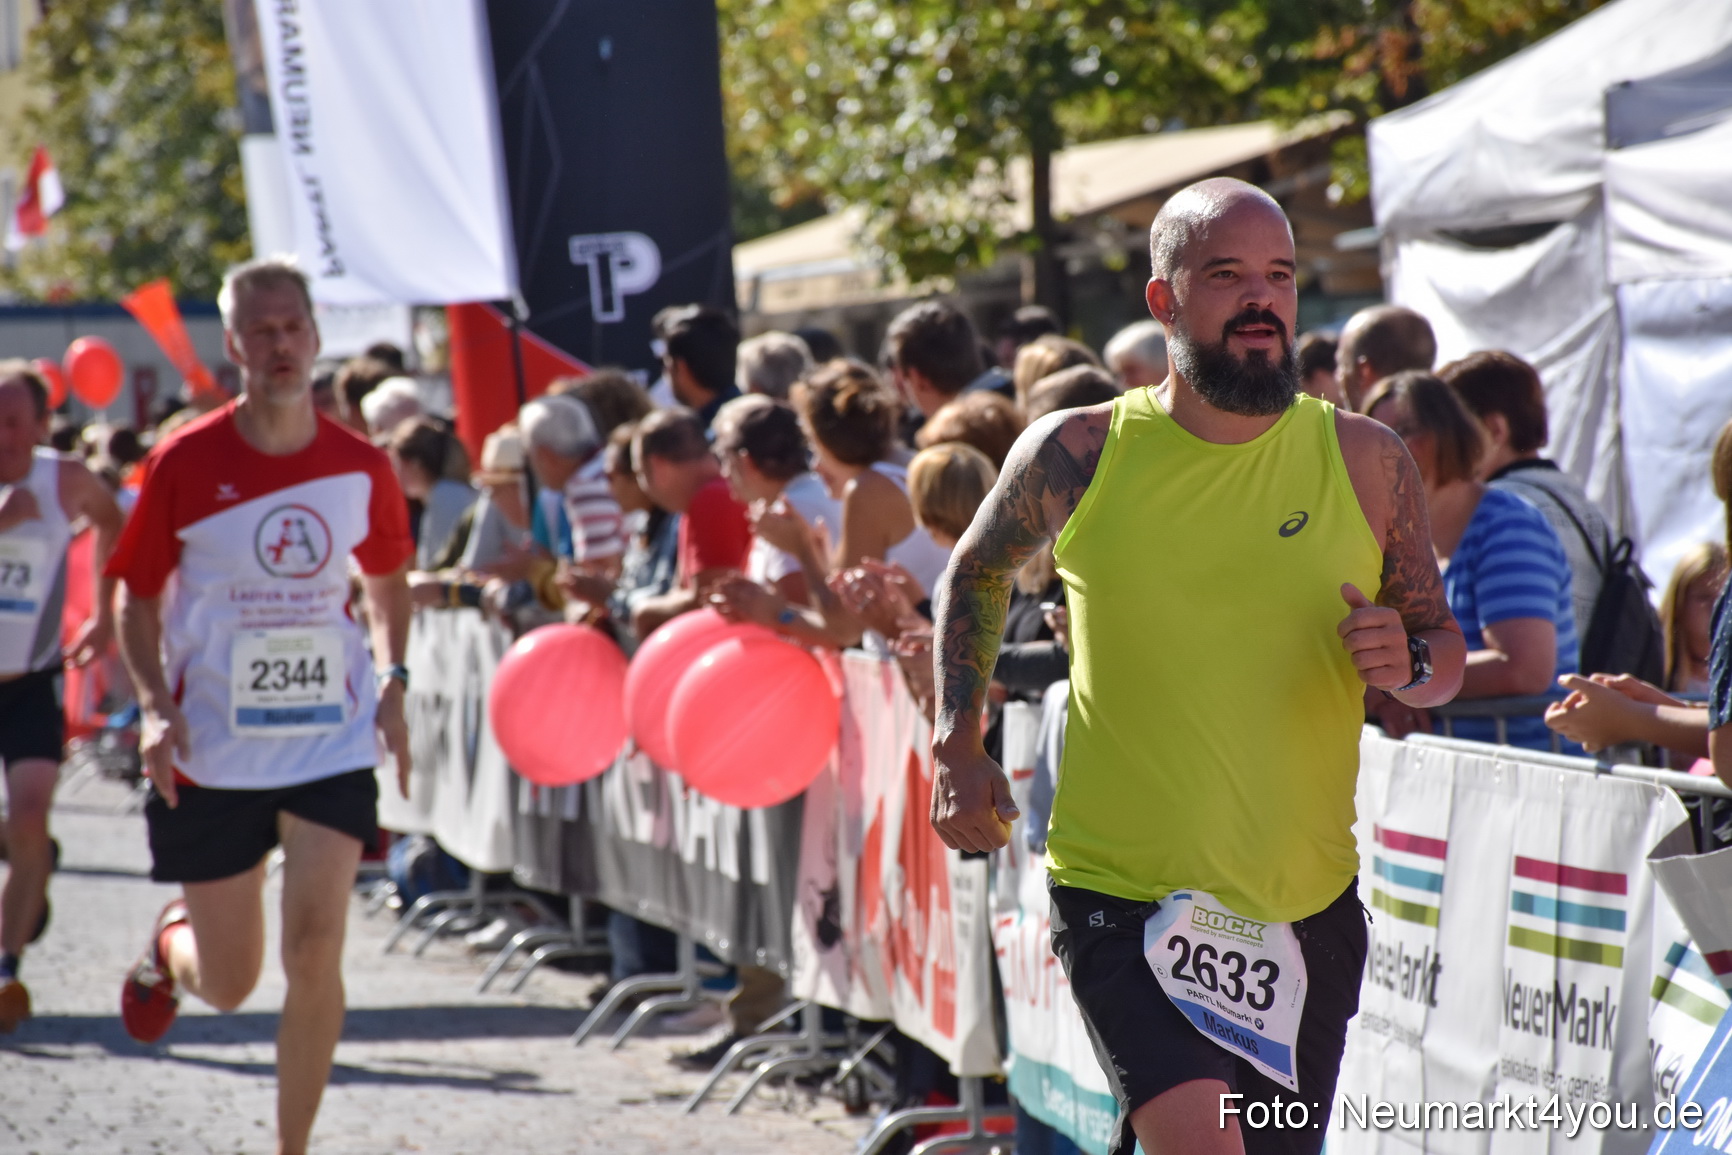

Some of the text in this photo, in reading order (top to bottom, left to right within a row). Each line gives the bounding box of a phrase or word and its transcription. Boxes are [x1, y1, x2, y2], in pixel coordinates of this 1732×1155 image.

[250, 656, 328, 692] 2344
[1190, 924, 1264, 948] inspired by smart concepts
[1192, 905, 1267, 942] BOCK
[1167, 935, 1280, 1012] 2633
[1186, 988, 1254, 1025] PARTL Neumarkt
[1203, 1011, 1259, 1056] Markus
